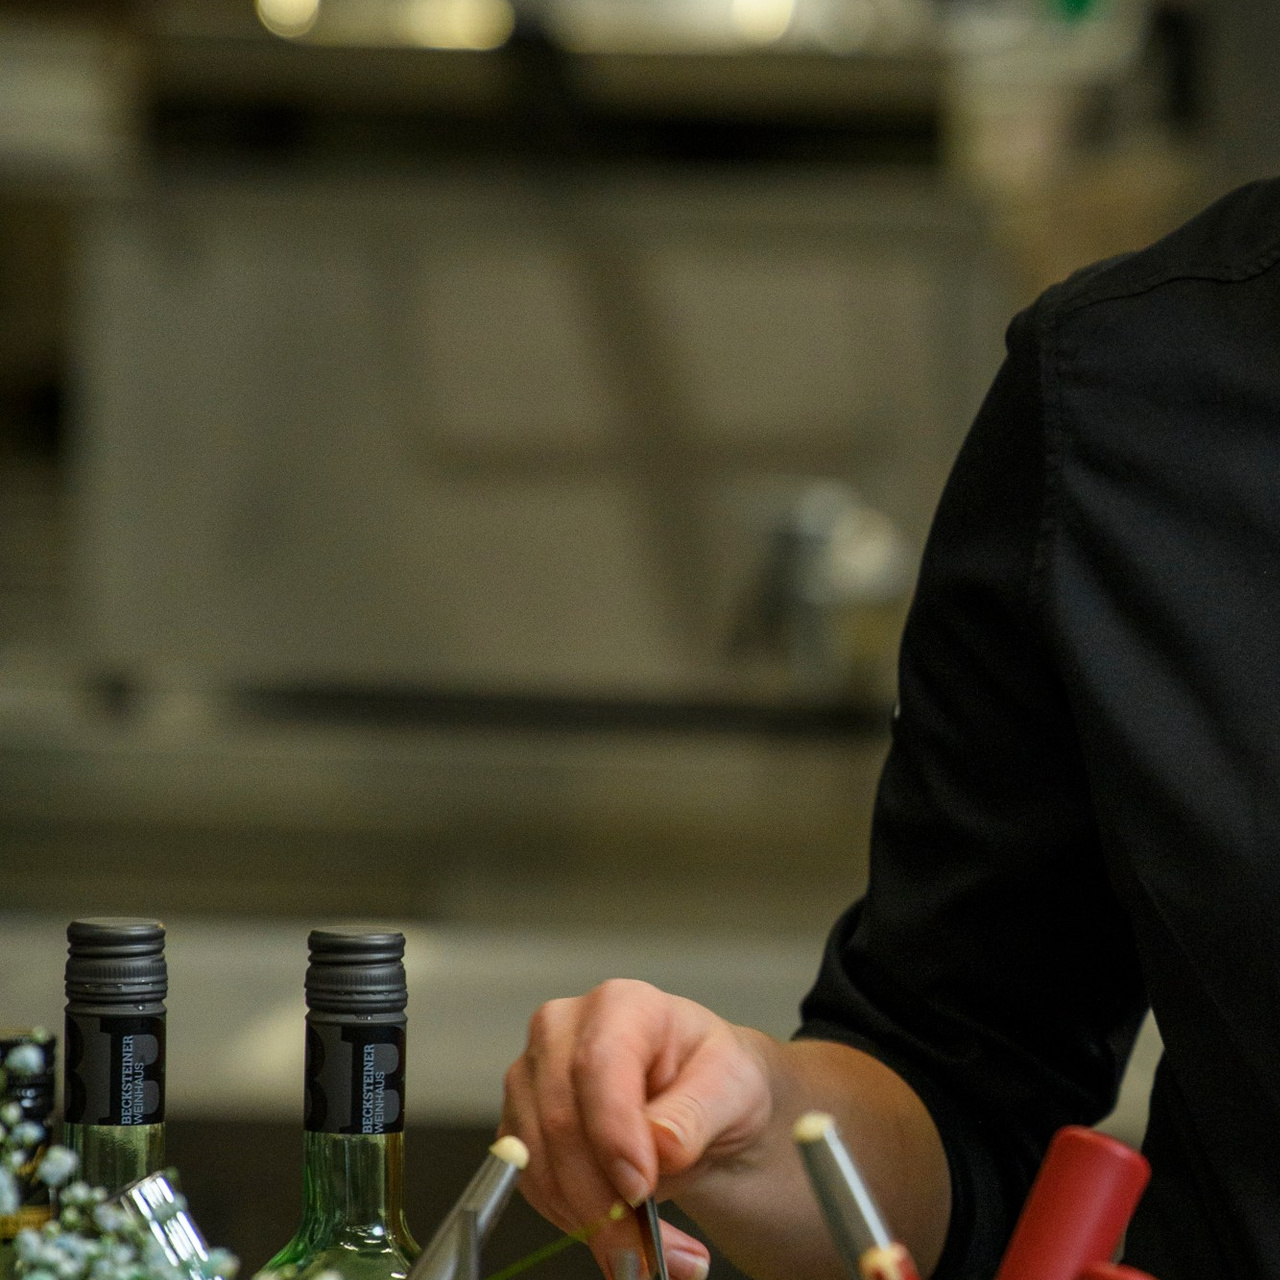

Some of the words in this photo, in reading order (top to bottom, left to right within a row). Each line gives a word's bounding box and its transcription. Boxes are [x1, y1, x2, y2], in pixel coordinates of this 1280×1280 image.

[121, 1035, 133, 1125] BECKSTEINER
[133, 1062, 144, 1125] WEINHAUS
[362, 1043, 374, 1134] BECKSTEINER
[374, 1071, 385, 1134] WEINHAUS
